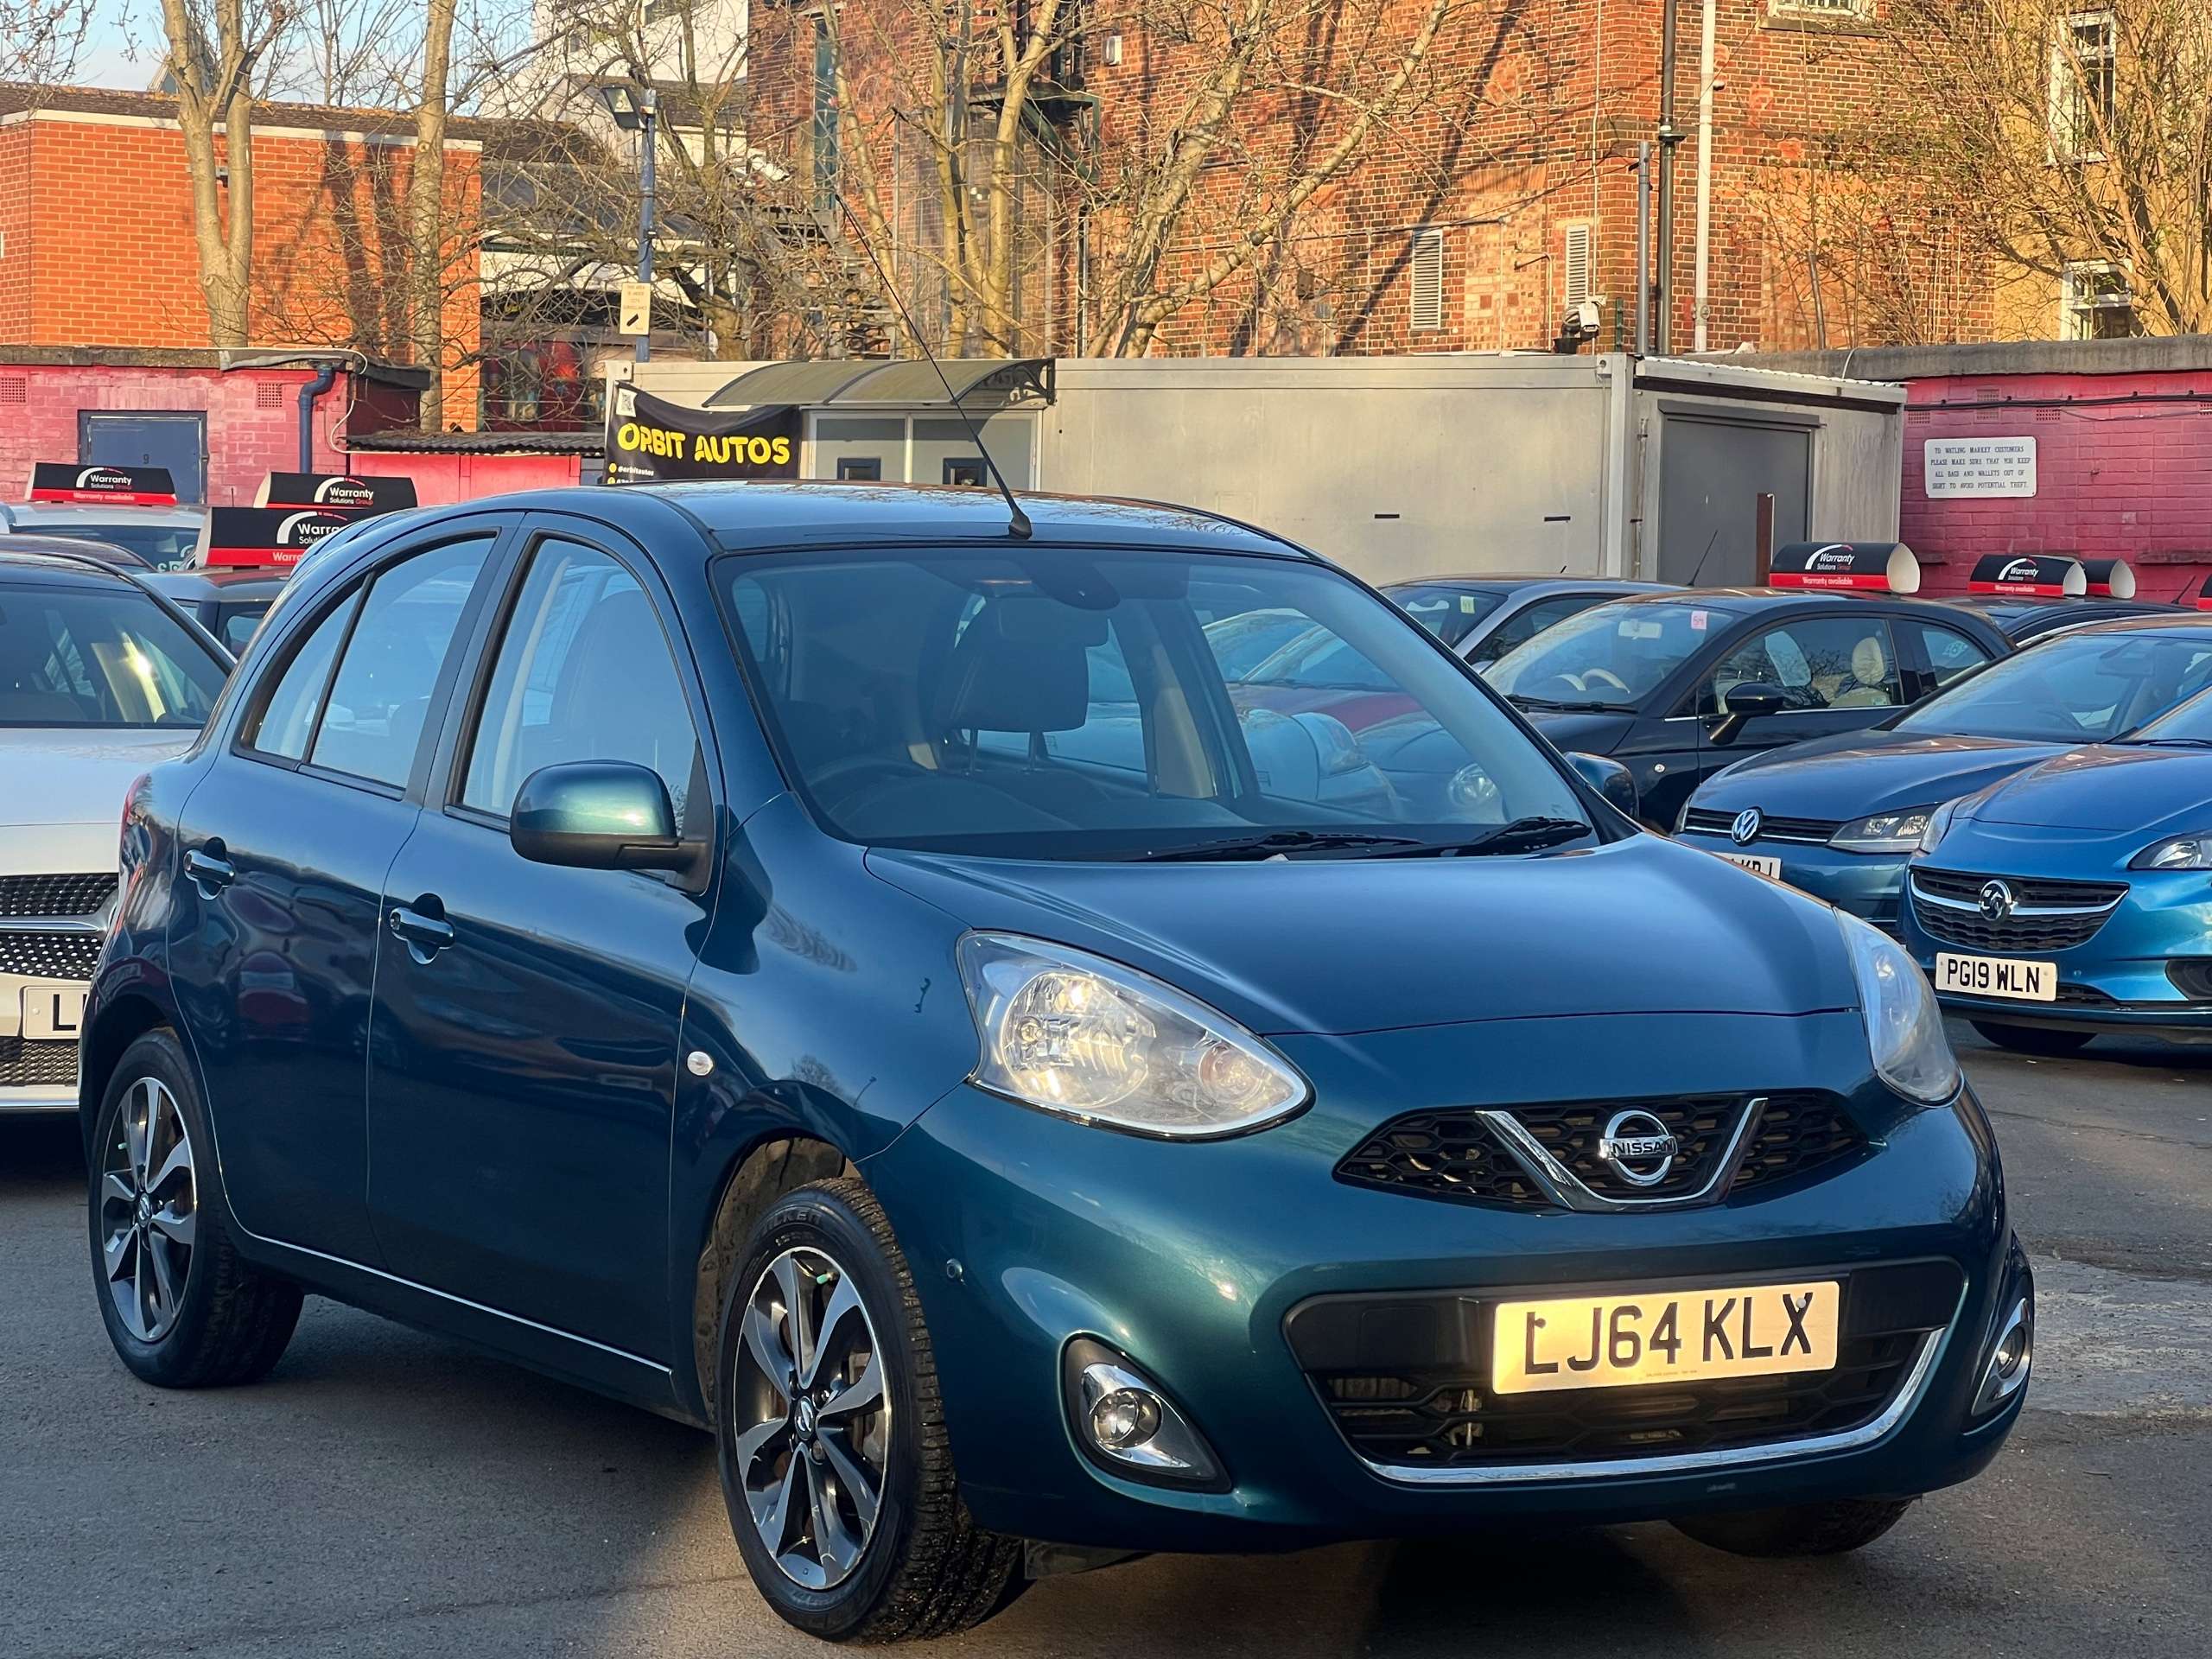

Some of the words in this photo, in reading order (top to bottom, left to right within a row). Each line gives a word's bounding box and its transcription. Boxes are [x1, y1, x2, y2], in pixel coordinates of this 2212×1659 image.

[617, 423, 686, 460] ORBIT
[694, 435, 791, 465] AUTOS
[143, 454, 149, 464] 9
[90, 474, 132, 486] Warranty
[329, 487, 374, 499] Warranty
[1820, 553, 1855, 565] Warranty
[2010, 567, 2039, 577] Warranty
[1947, 958, 1989, 988] PG19
[1996, 963, 2040, 993] WLN
[1611, 1139, 1676, 1154] NISSAN
[1525, 1302, 1681, 1375] LJ64
[1703, 1292, 1814, 1362] KLX
